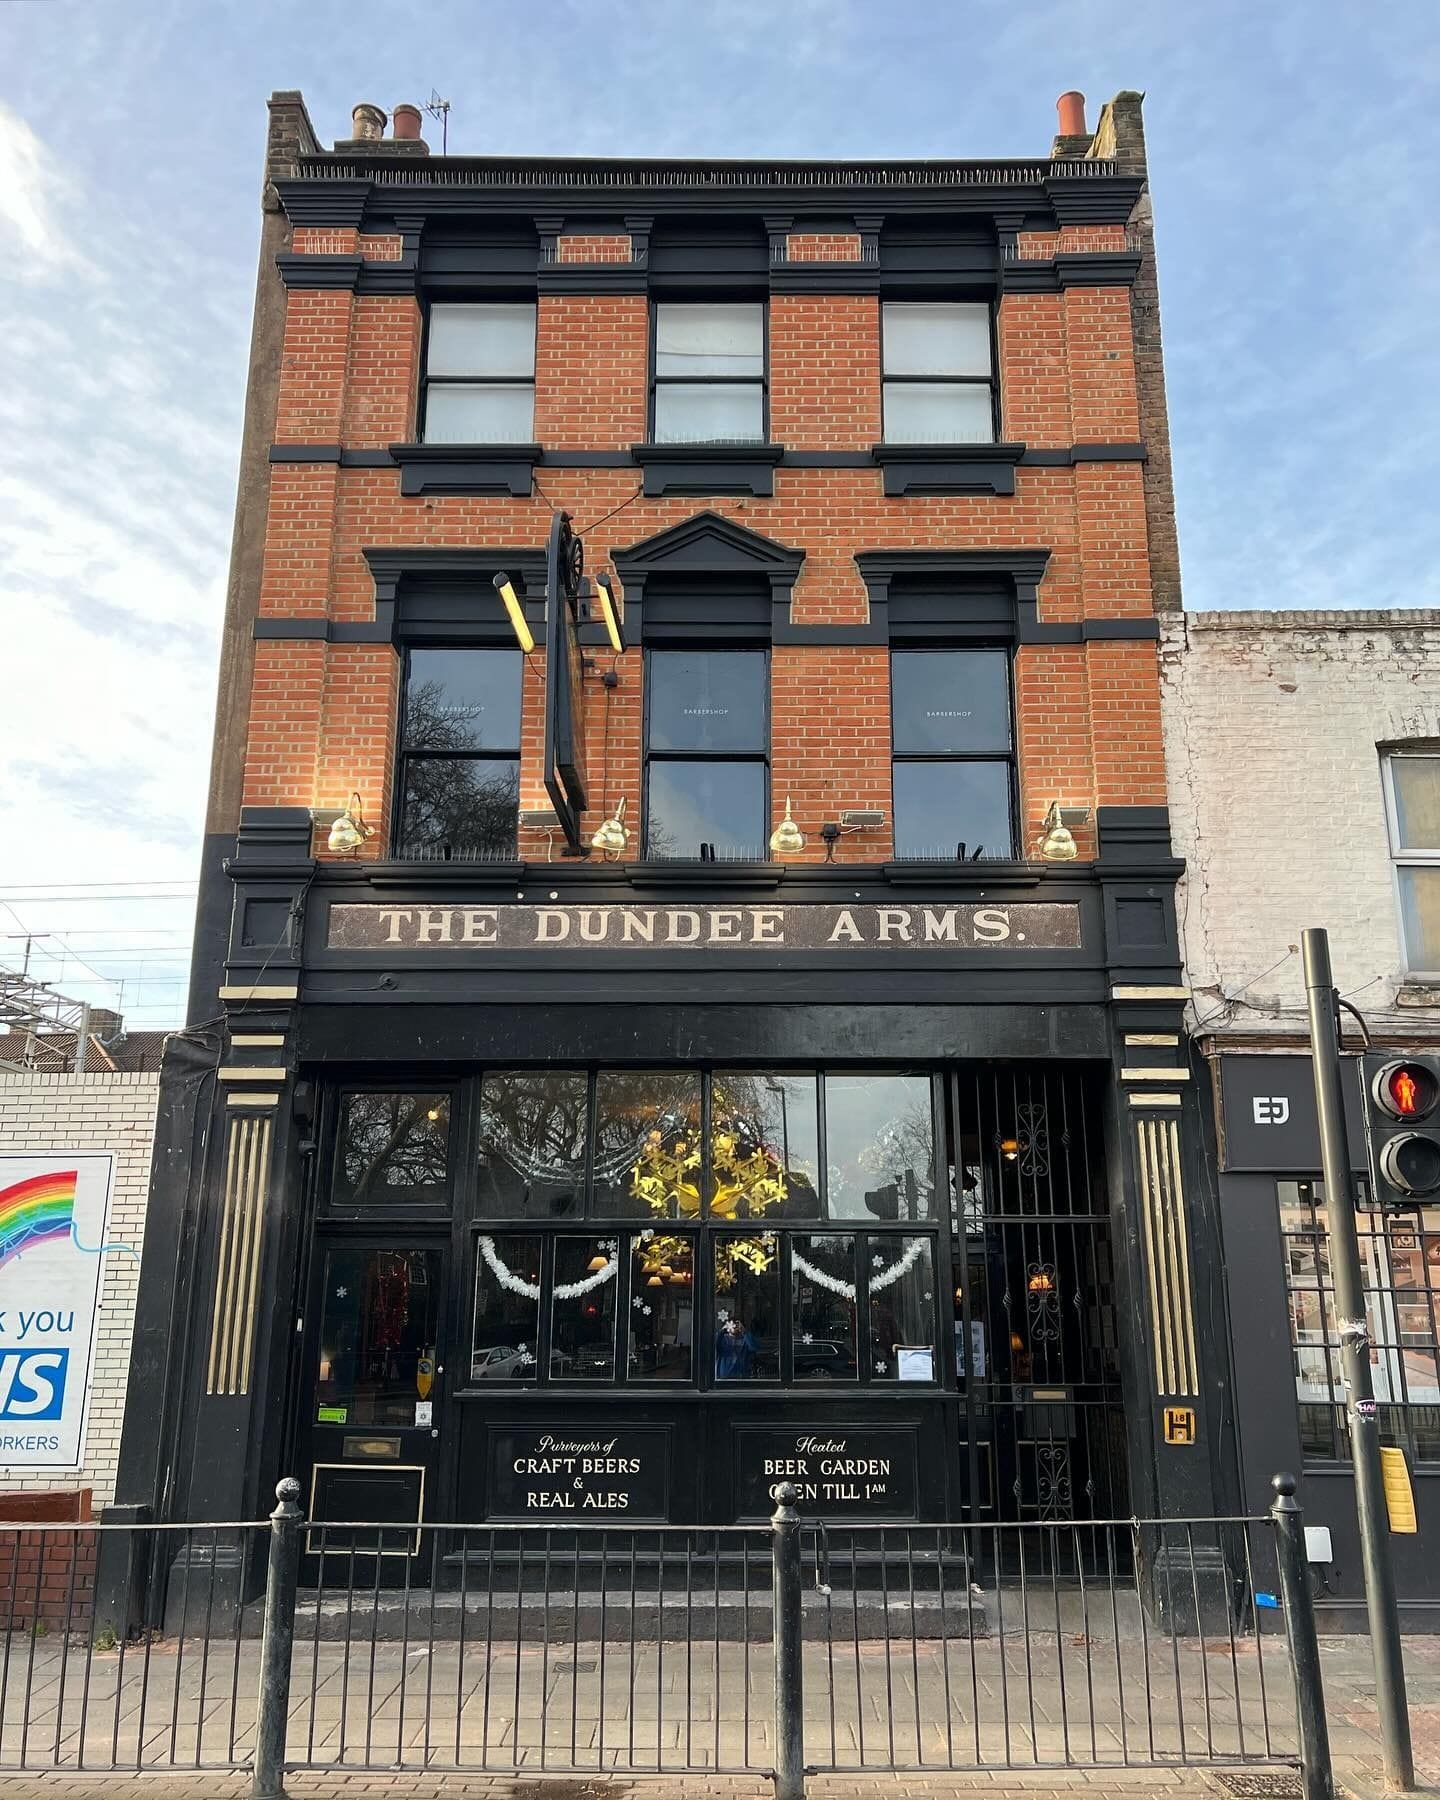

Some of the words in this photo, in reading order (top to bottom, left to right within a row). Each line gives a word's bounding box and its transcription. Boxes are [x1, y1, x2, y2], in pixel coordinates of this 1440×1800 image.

[379, 910, 498, 942] THE
[534, 910, 785, 942] DUNDEE
[826, 909, 1026, 942] ARMS.
[16, 1310, 74, 1340] you
[0, 1436, 59, 1450] RKERS
[534, 1435, 600, 1457] Purveyors
[602, 1437, 619, 1457] of
[795, 1436, 847, 1456] Heated
[513, 1458, 576, 1474] CRAFT
[582, 1458, 641, 1474] BEERS
[764, 1459, 809, 1475] BEER
[820, 1459, 890, 1475] GARDEN
[573, 1477, 584, 1489] &
[822, 1483, 861, 1499] TILL
[526, 1492, 575, 1508] REAL
[582, 1492, 629, 1508] ALES
